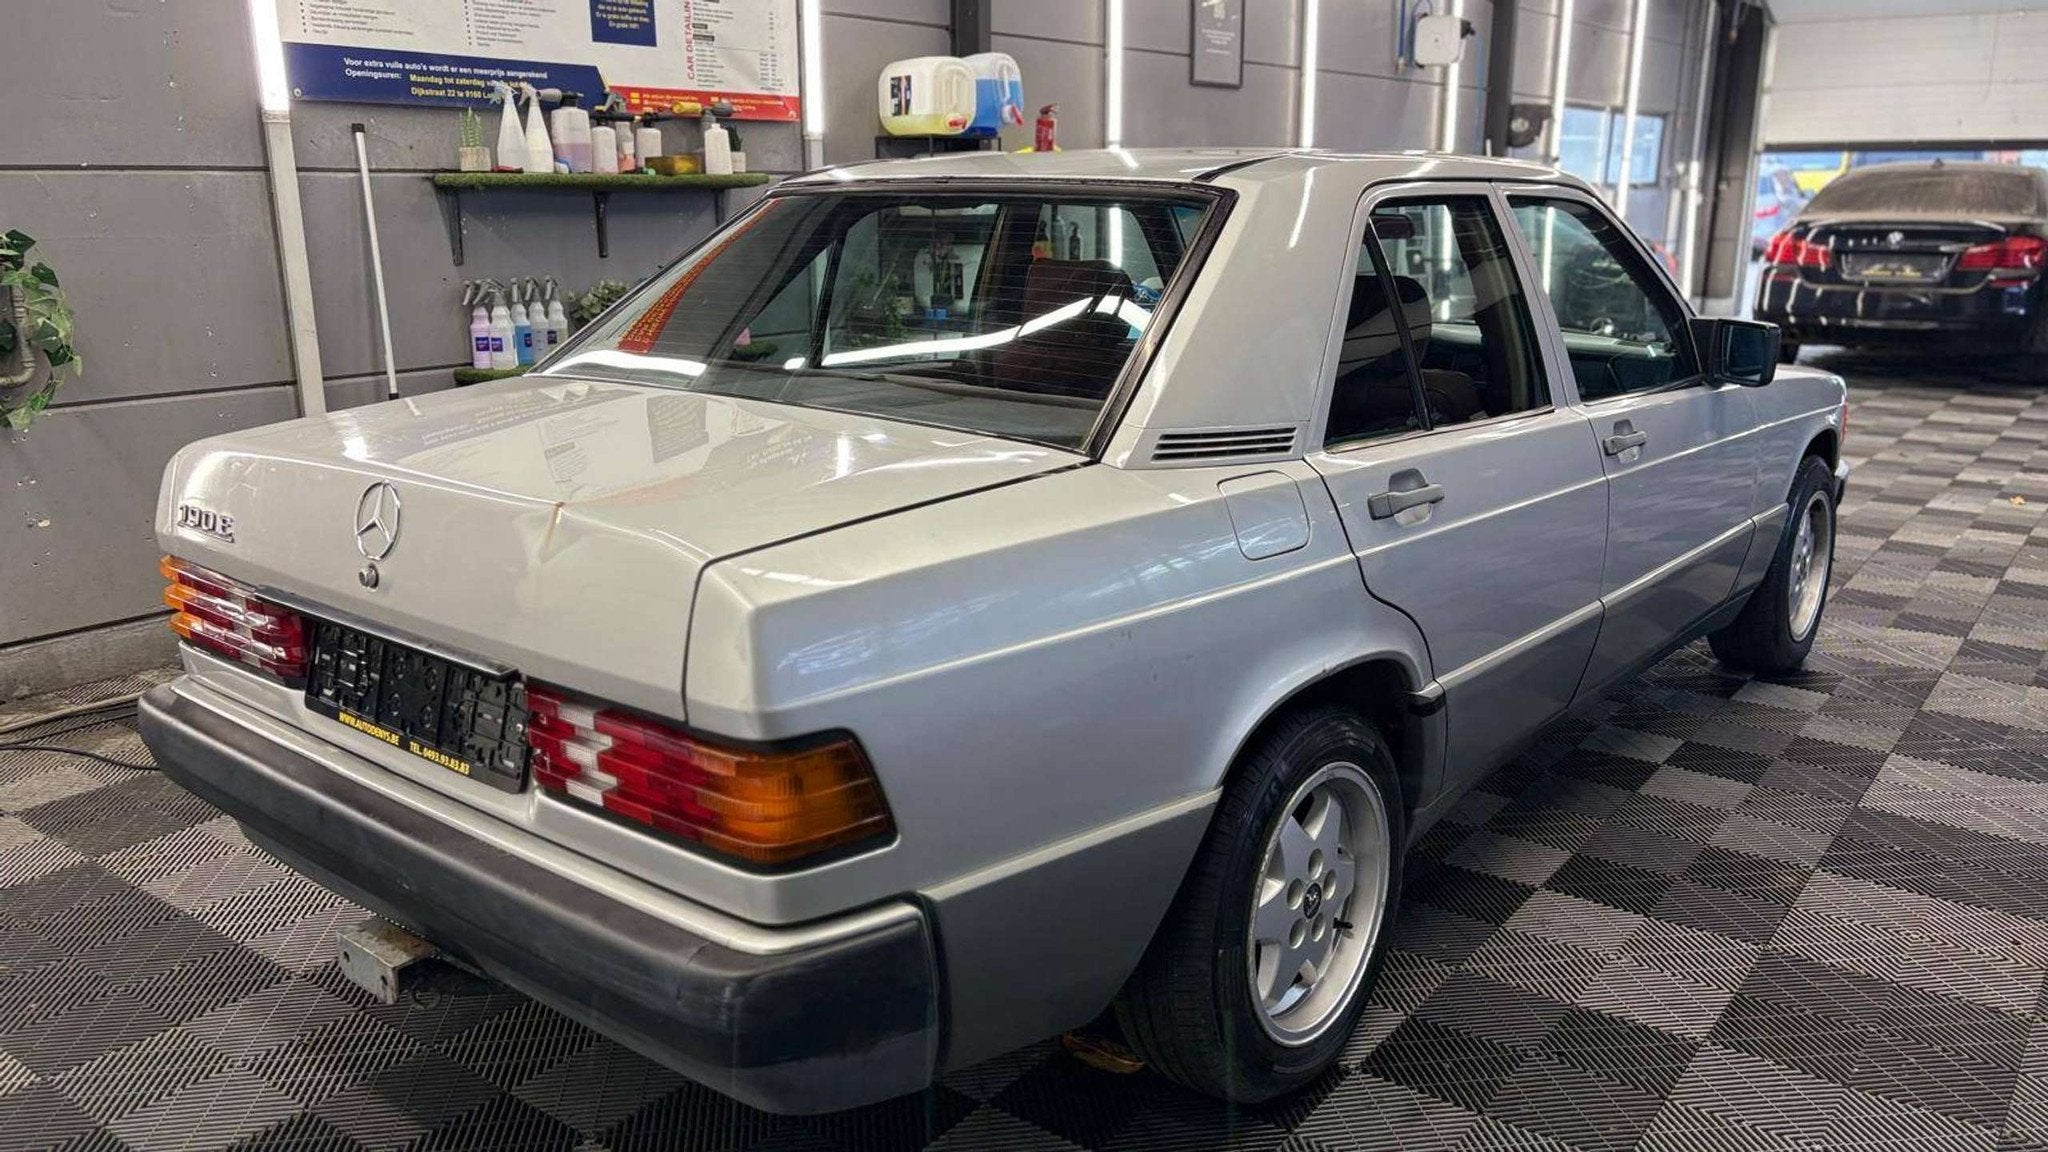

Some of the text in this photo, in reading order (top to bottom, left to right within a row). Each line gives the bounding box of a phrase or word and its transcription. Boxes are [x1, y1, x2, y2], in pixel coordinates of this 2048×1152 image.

[343, 57, 363, 67] Voor
[364, 60, 384, 69] extra
[385, 60, 403, 70] vulle
[404, 62, 427, 71] auto's
[428, 64, 449, 73] wordt
[459, 67, 472, 75] een
[473, 67, 505, 78] meerprijs
[345, 67, 402, 80] Openingsuren:
[686, 56, 695, 80] CAR
[409, 73, 443, 85] Maandag
[444, 76, 454, 84] tot
[455, 77, 485, 88] zaterdag
[411, 86, 446, 97] Dijkstraat
[447, 89, 456, 97] 22
